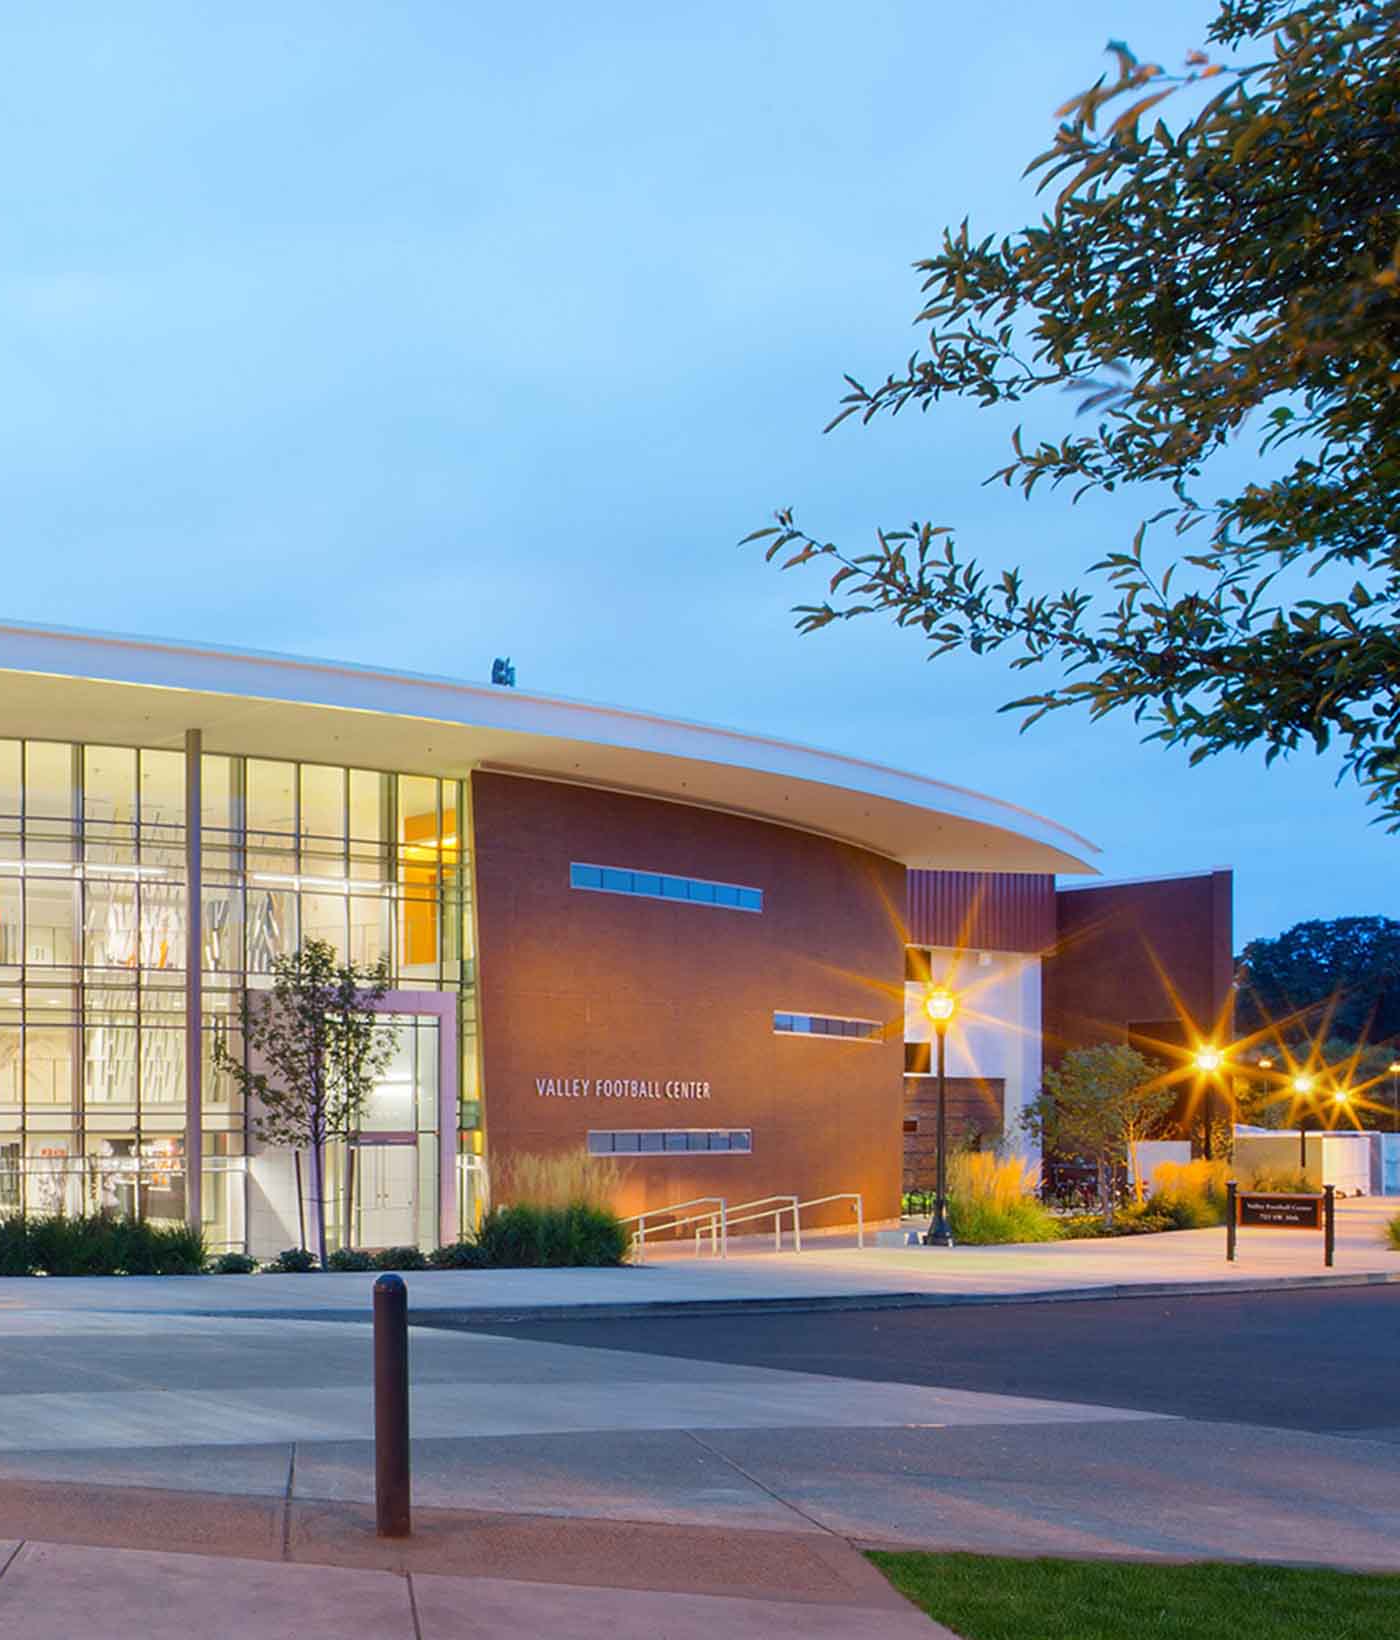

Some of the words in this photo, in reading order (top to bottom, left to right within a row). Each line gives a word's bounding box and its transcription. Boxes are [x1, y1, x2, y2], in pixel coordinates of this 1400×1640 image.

[536, 1078, 590, 1097] VALLEY
[595, 1079, 661, 1099] FOOTBALL
[665, 1081, 711, 1099] CENTER
